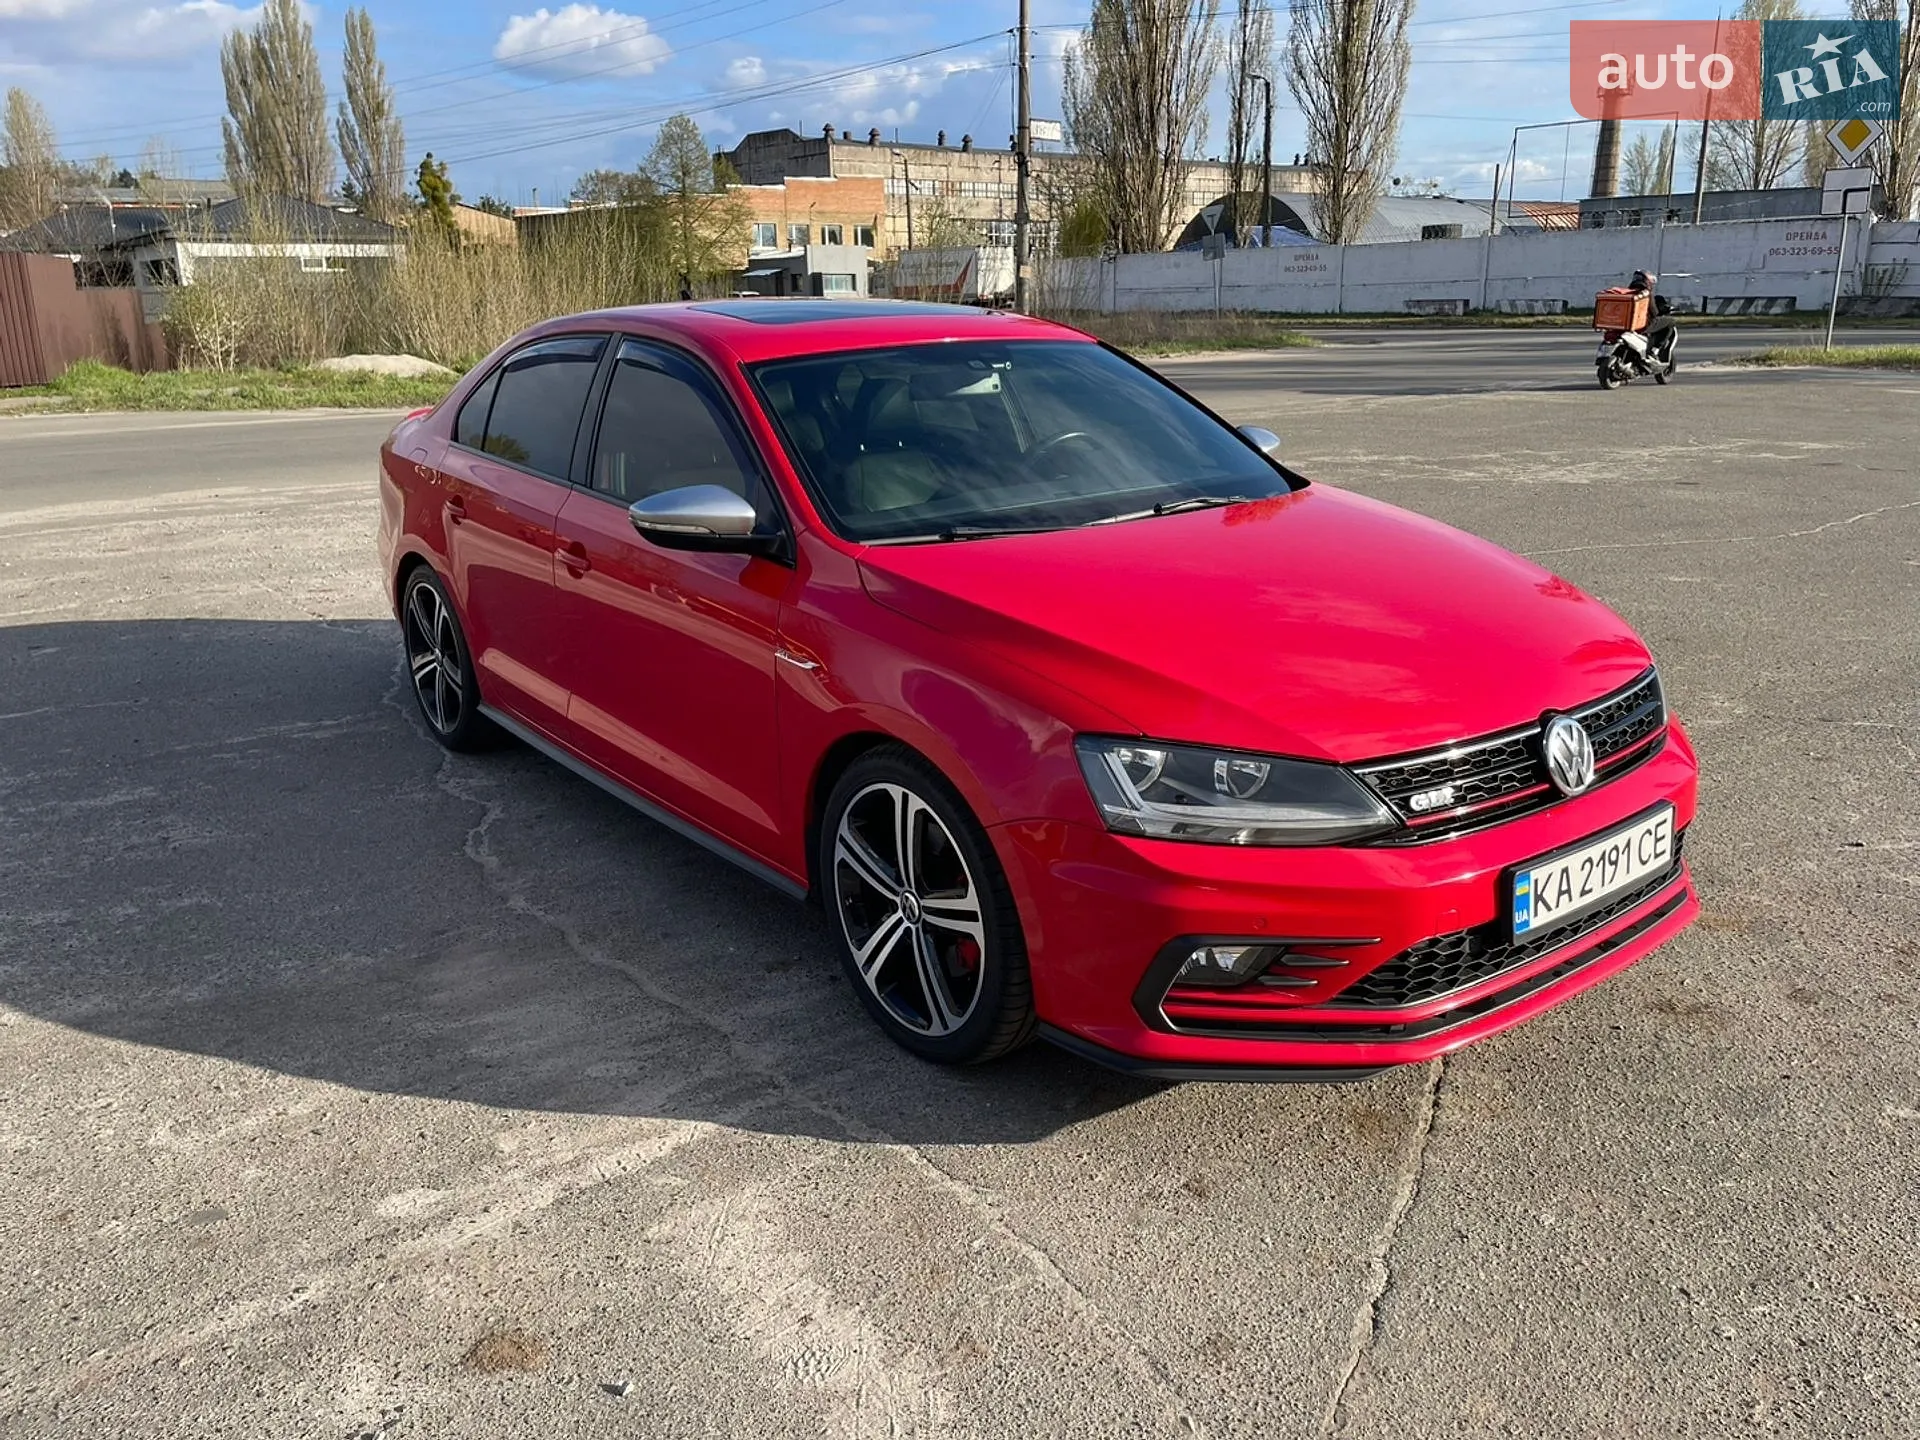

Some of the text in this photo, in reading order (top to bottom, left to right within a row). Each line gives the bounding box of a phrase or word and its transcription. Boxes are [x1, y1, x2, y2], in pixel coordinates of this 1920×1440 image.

[1532, 819, 1668, 919] KA 2191 CE
[1515, 908, 1529, 922] UA
